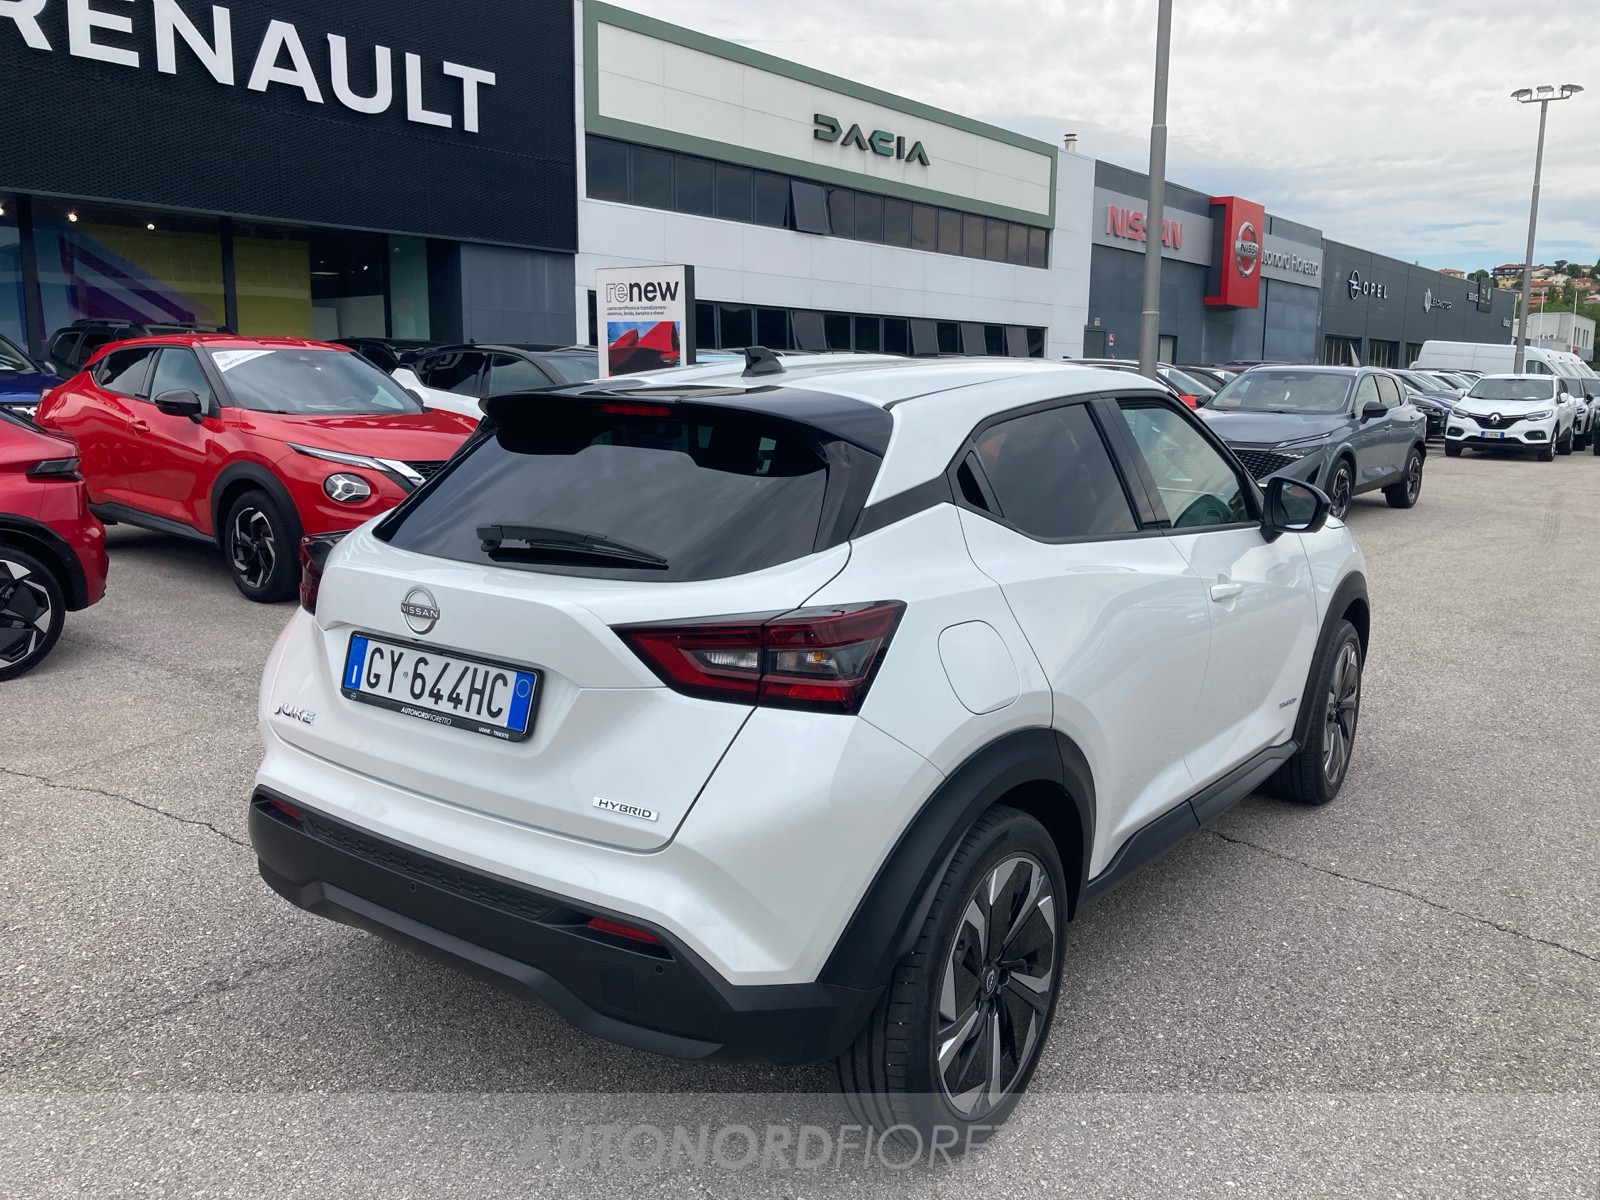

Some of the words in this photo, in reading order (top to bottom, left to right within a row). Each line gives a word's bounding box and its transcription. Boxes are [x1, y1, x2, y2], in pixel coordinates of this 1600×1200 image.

[813, 113, 931, 167] DACIA
[1106, 204, 1183, 250] NISAN
[1291, 252, 1319, 276] Fioretto
[606, 281, 679, 303] renew
[1363, 281, 1388, 299] OPEL
[401, 603, 439, 618] NISSAN
[366, 647, 404, 694] GY
[410, 656, 509, 719] 644HC
[274, 702, 315, 726] JUKE
[401, 707, 452, 725] AUTONORDFIORETTO
[599, 799, 652, 818] HYBRID
